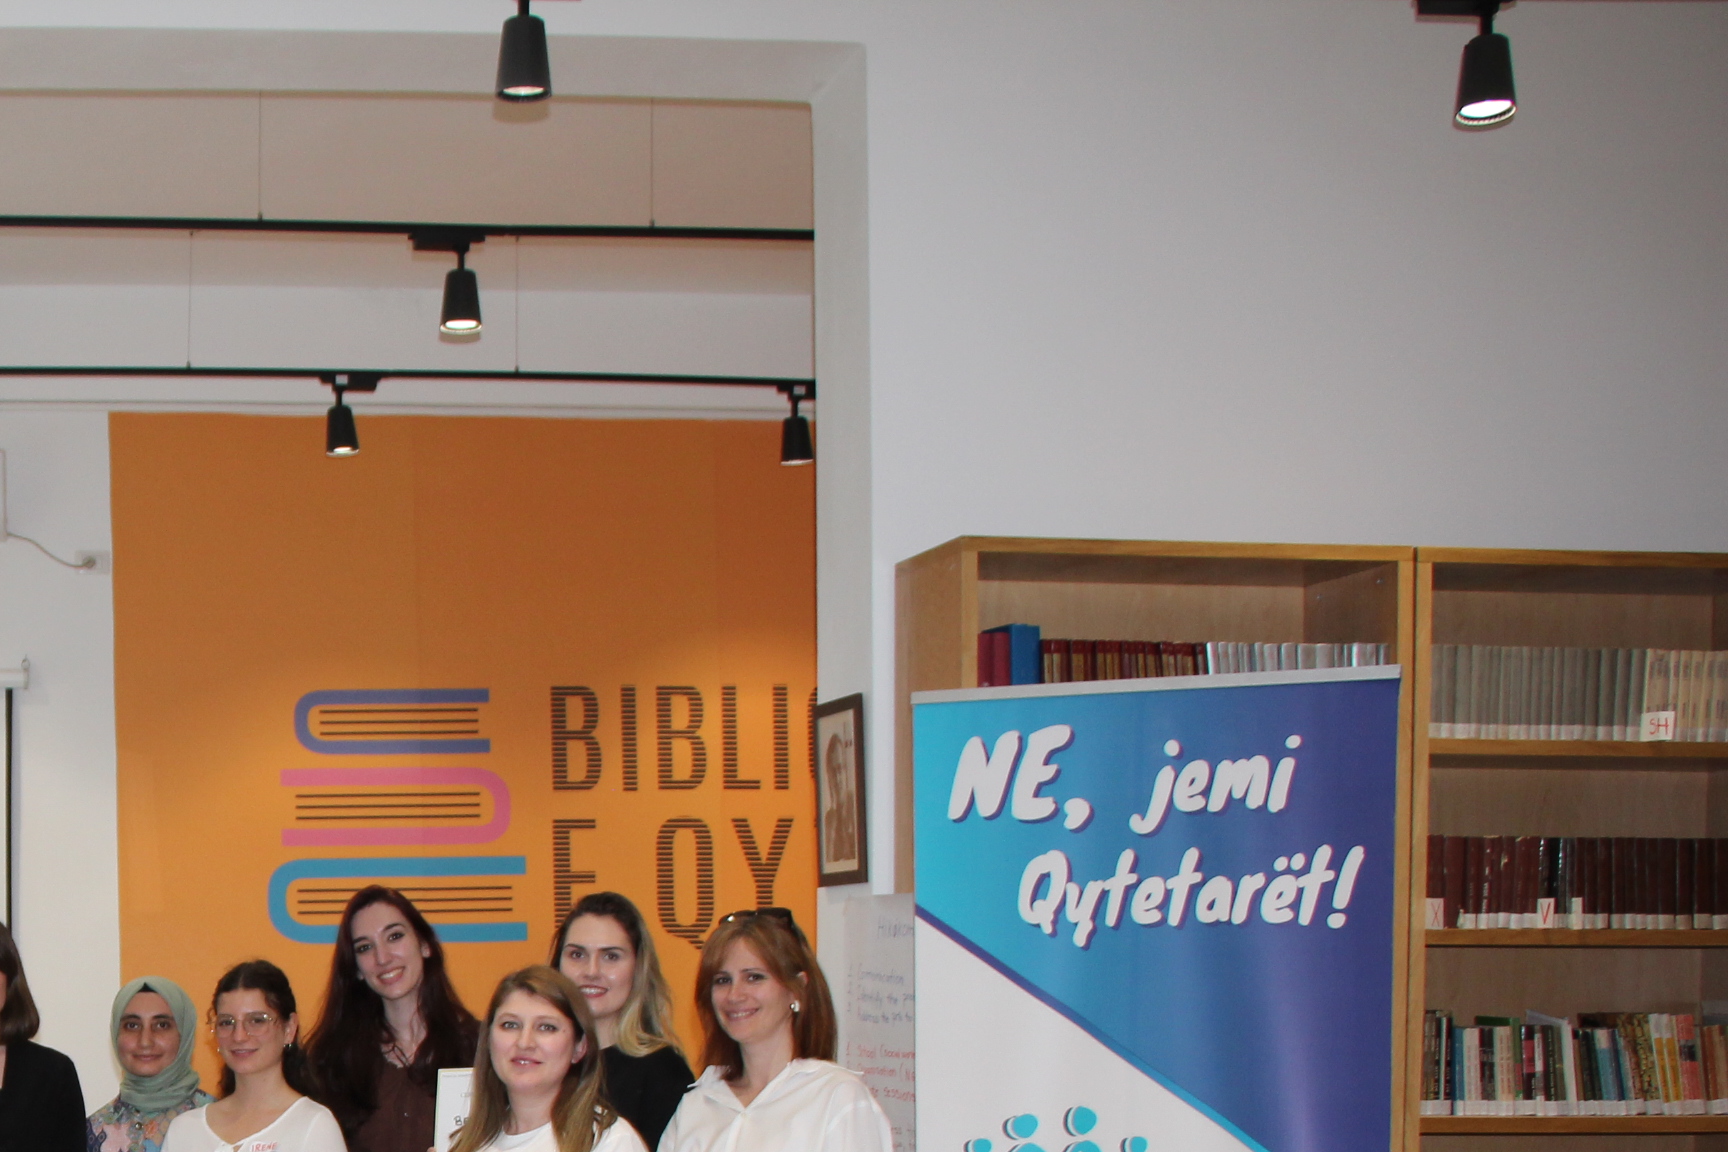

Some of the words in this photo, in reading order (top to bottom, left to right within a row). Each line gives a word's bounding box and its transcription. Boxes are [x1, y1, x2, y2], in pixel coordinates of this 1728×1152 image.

[550, 684, 817, 792] BIBLI
[948, 724, 1093, 830] NE,
[1129, 735, 1301, 836] jemi
[656, 815, 793, 950] QY
[1018, 845, 1365, 948] Qytetarët!
